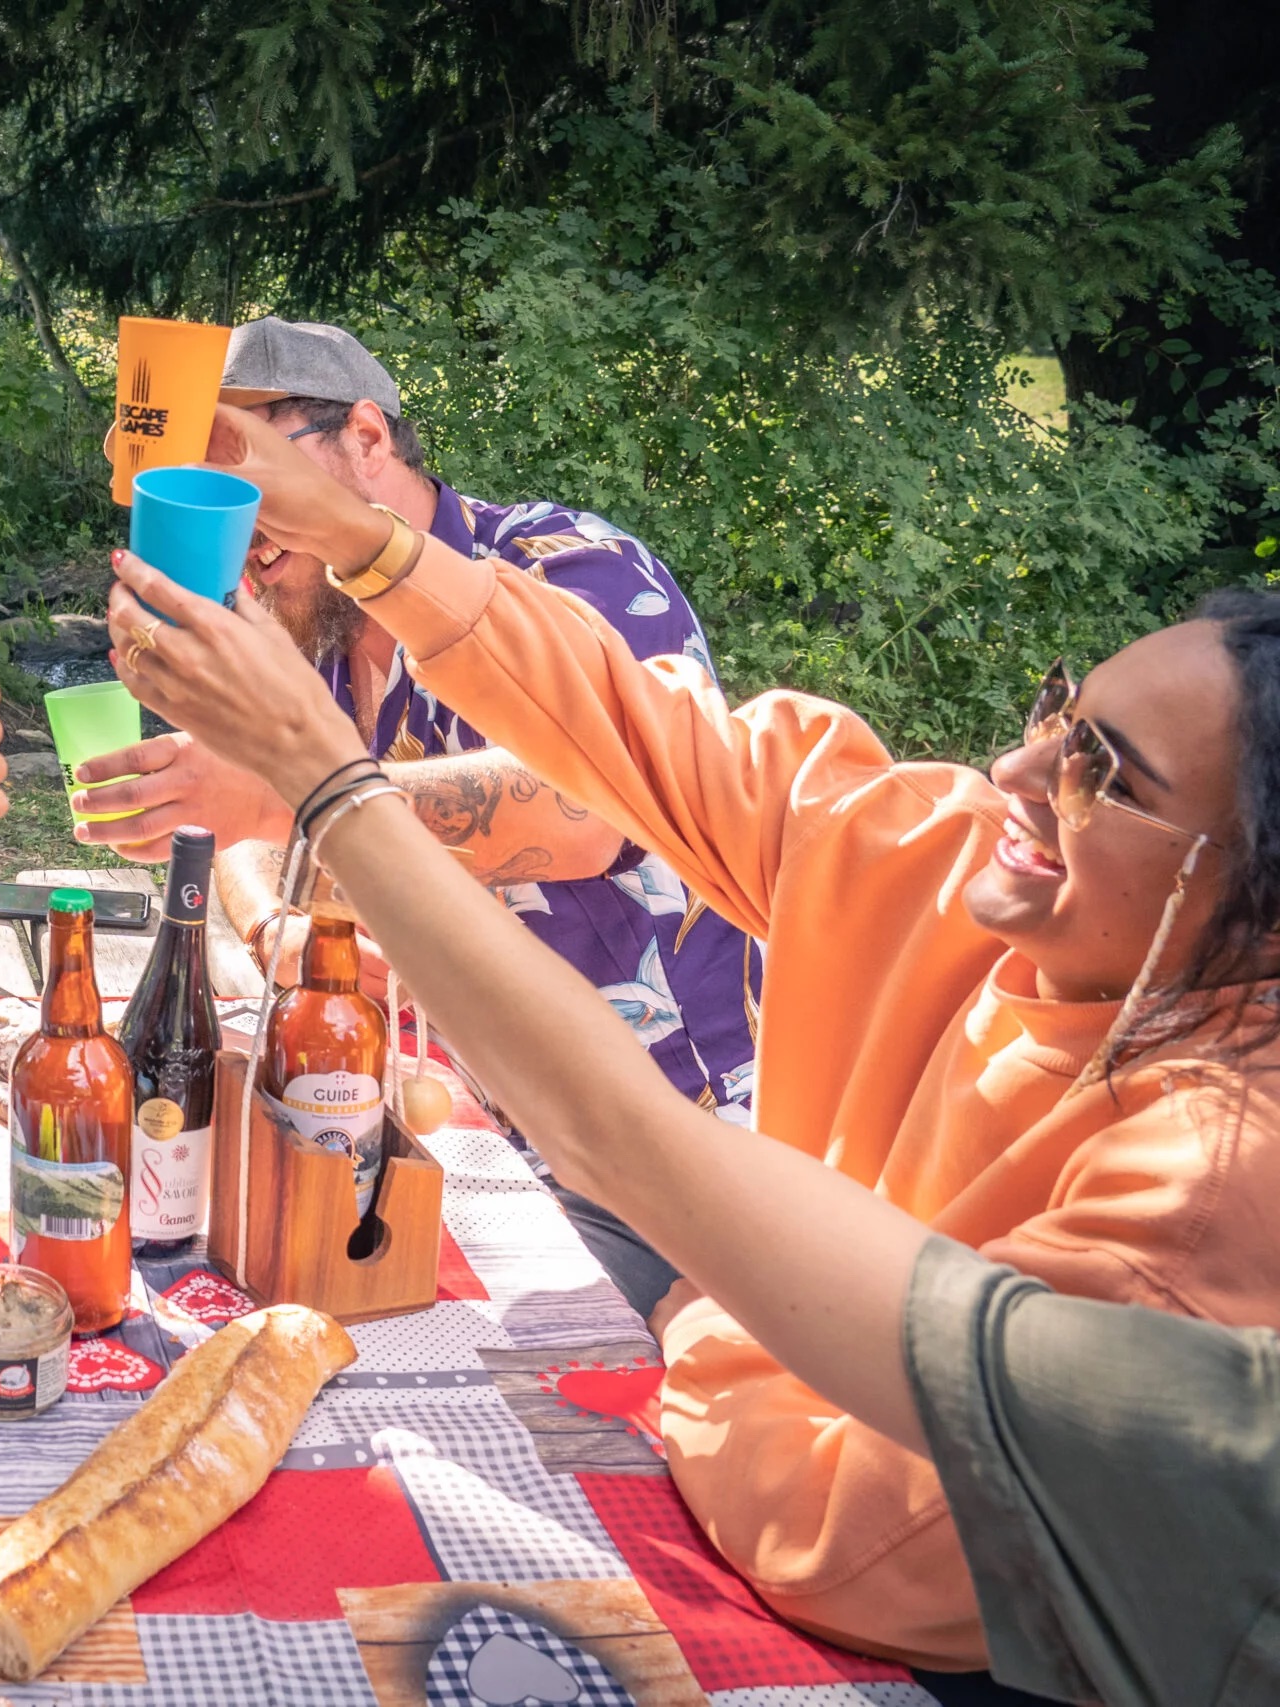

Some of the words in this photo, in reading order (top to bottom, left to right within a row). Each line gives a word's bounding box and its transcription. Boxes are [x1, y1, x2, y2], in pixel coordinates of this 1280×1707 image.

[120, 403, 169, 423] ESCAPE
[120, 420, 164, 437] GAMES
[313, 1088, 360, 1102] GUIDE
[159, 1212, 196, 1226] Gamay
